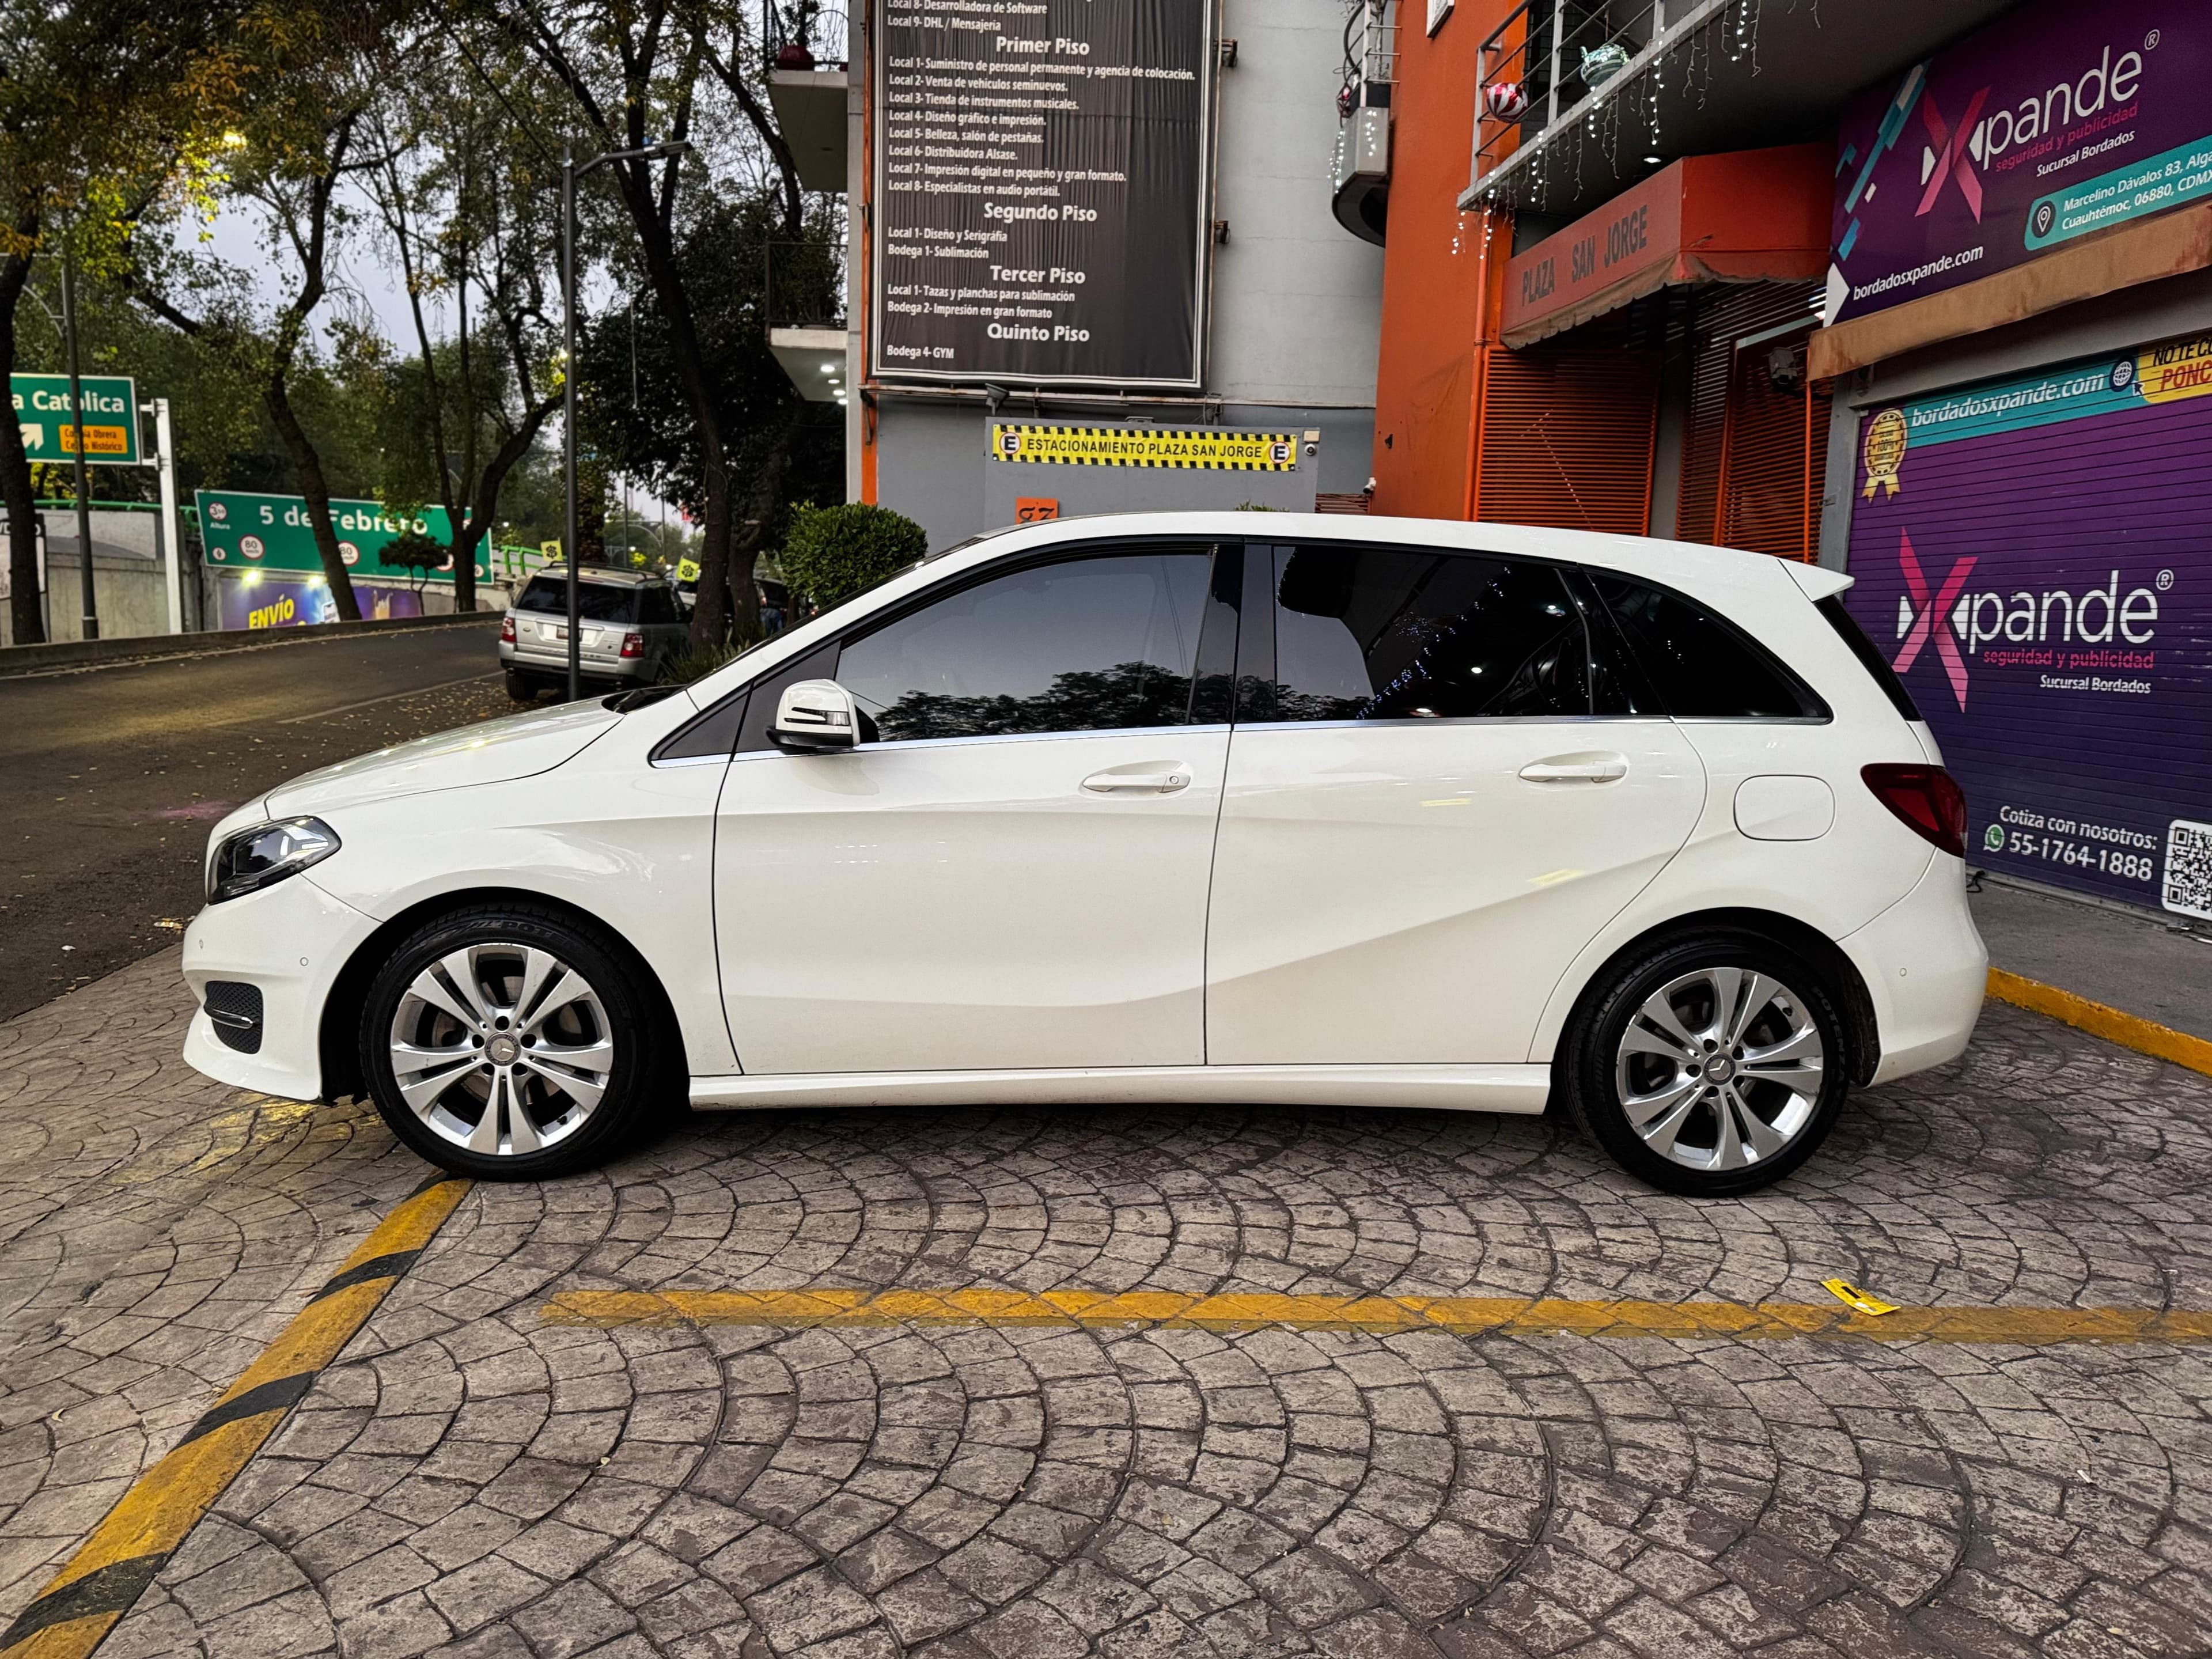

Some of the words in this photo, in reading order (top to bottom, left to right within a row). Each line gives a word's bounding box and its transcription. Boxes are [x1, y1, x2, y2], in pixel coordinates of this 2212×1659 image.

[924, 0, 991, 13] Desarrolladora
[993, 2, 1005, 13] de
[1006, 2, 1047, 14] Software
[888, 14, 912, 26] Local
[913, 16, 922, 27] 9-
[923, 16, 944, 28] DHL
[996, 36, 1052, 53] Primer
[1055, 37, 1090, 55] Piso
[889, 56, 914, 67] Local
[916, 57, 924, 68] 1-
[925, 57, 974, 71] Suministro
[975, 60, 988, 71] de
[988, 61, 1029, 75] personal
[1030, 63, 1086, 76] permanente
[1086, 66, 1093, 78] y
[1094, 65, 1130, 79] agencia
[1132, 66, 1144, 77] de
[1145, 67, 1195, 80] colocación.
[889, 74, 914, 85] Local
[915, 75, 924, 86] 2-
[925, 75, 953, 87] Venta
[954, 77, 967, 88] de
[1012, 79, 1068, 92] seminuevos.
[889, 91, 913, 103] Local
[915, 92, 924, 104] 3-
[925, 93, 956, 105] Tienda
[958, 94, 970, 106] de
[971, 94, 1032, 108] instrumentos
[1033, 97, 1080, 109] musicales.
[889, 109, 913, 121] Local
[914, 110, 923, 121] 4-
[925, 111, 956, 123] Diseño
[958, 112, 990, 126] gráfico
[991, 115, 998, 124] e
[999, 113, 1047, 128] impresión.
[889, 127, 913, 138] Local
[915, 128, 923, 139] 5-
[925, 128, 960, 142] Belleza,
[961, 130, 986, 141] salón
[987, 131, 1000, 142] de
[1001, 131, 1044, 145] pestañas.
[1996, 137, 2054, 172] seguridad
[2056, 135, 2064, 150] y
[2067, 101, 2138, 145] publicidad
[889, 145, 913, 156] Local
[914, 145, 923, 157] 6-
[925, 145, 984, 159] Distribuidora
[985, 148, 1018, 160] Alsase.
[2037, 150, 2079, 177] Sucursal
[2081, 131, 2135, 160] Bordados
[888, 162, 913, 173] Local
[914, 162, 923, 174] 7-
[925, 163, 970, 178] Impresión
[971, 165, 1001, 180] digital
[1002, 168, 1014, 177] en
[1016, 168, 1056, 181] pequeño
[1056, 171, 1063, 183] y
[1064, 171, 1086, 183] gran
[1087, 169, 1127, 181] formato.
[888, 179, 912, 191] Local
[914, 180, 923, 191] 8-
[925, 180, 982, 195] Especialistas
[983, 185, 995, 194] en
[996, 184, 1022, 195] audio
[1024, 185, 1060, 199] portátil.
[2064, 186, 2115, 211] Marcelino
[2118, 169, 2162, 194] Dávalos
[2165, 161, 2184, 176] 83,
[984, 202, 1058, 224] Segundo
[1062, 205, 1097, 222] Piso
[2062, 200, 2131, 230] Cuauhtémoc,
[2134, 184, 2174, 206] 06880,
[888, 226, 912, 238] Local
[915, 227, 922, 238] 1-
[923, 228, 955, 240] Diseño
[956, 232, 963, 244] y
[888, 244, 923, 259] Bodega
[925, 245, 933, 256] 1-
[934, 245, 989, 259] Sublimación
[1522, 256, 1555, 307] PLAZA
[1572, 235, 1595, 283] SAN
[1604, 204, 1647, 268] JORGE
[990, 265, 1046, 282] Tercer
[1050, 267, 1086, 284] Piso
[1853, 245, 1984, 301] bordadosxpande.com
[888, 283, 912, 295] Local
[914, 285, 922, 296] 1-
[923, 285, 949, 297] Tazas
[949, 289, 956, 301] y
[957, 287, 998, 301] planchas
[999, 290, 1020, 302] para
[1021, 289, 1075, 301] sublimación
[888, 301, 922, 316] Bodega
[923, 302, 933, 313] 2-
[933, 303, 979, 317] Impresión
[980, 307, 992, 316] en
[993, 307, 1015, 319] gran
[1016, 306, 1052, 319] formato
[987, 323, 1050, 341] Quinto
[1054, 325, 1090, 342] Piso
[887, 344, 922, 360] Bodega
[922, 346, 931, 357] 4-
[933, 347, 955, 359] GYM
[2153, 346, 2175, 366] NO
[2178, 340, 2198, 361] TE
[32, 390, 124, 412] Catlica
[1911, 372, 2104, 428] bordadosxpande.com
[94, 429, 117, 439] Obrera
[1004, 436, 1016, 450] E
[1028, 439, 1145, 454] ESTACIONAMIENTO
[1149, 443, 1188, 455] PLAZA
[1192, 444, 1217, 456] SAN
[1220, 445, 1262, 457] JORGE
[1274, 446, 1286, 460] E
[260, 505, 274, 525] 5
[284, 505, 313, 527] de
[245, 540, 257, 548] 80
[1984, 649, 2052, 666] seguridad
[2056, 652, 2065, 669] y
[2070, 650, 2154, 669] publicidad
[2040, 674, 2089, 690] Sucursal
[2092, 677, 2151, 694] Bordados
[1999, 806, 2044, 829] Cotiza
[2047, 817, 2076, 835] con
[2080, 823, 2158, 850] nosotros:
[2009, 831, 2153, 881] 55-1764-1888
